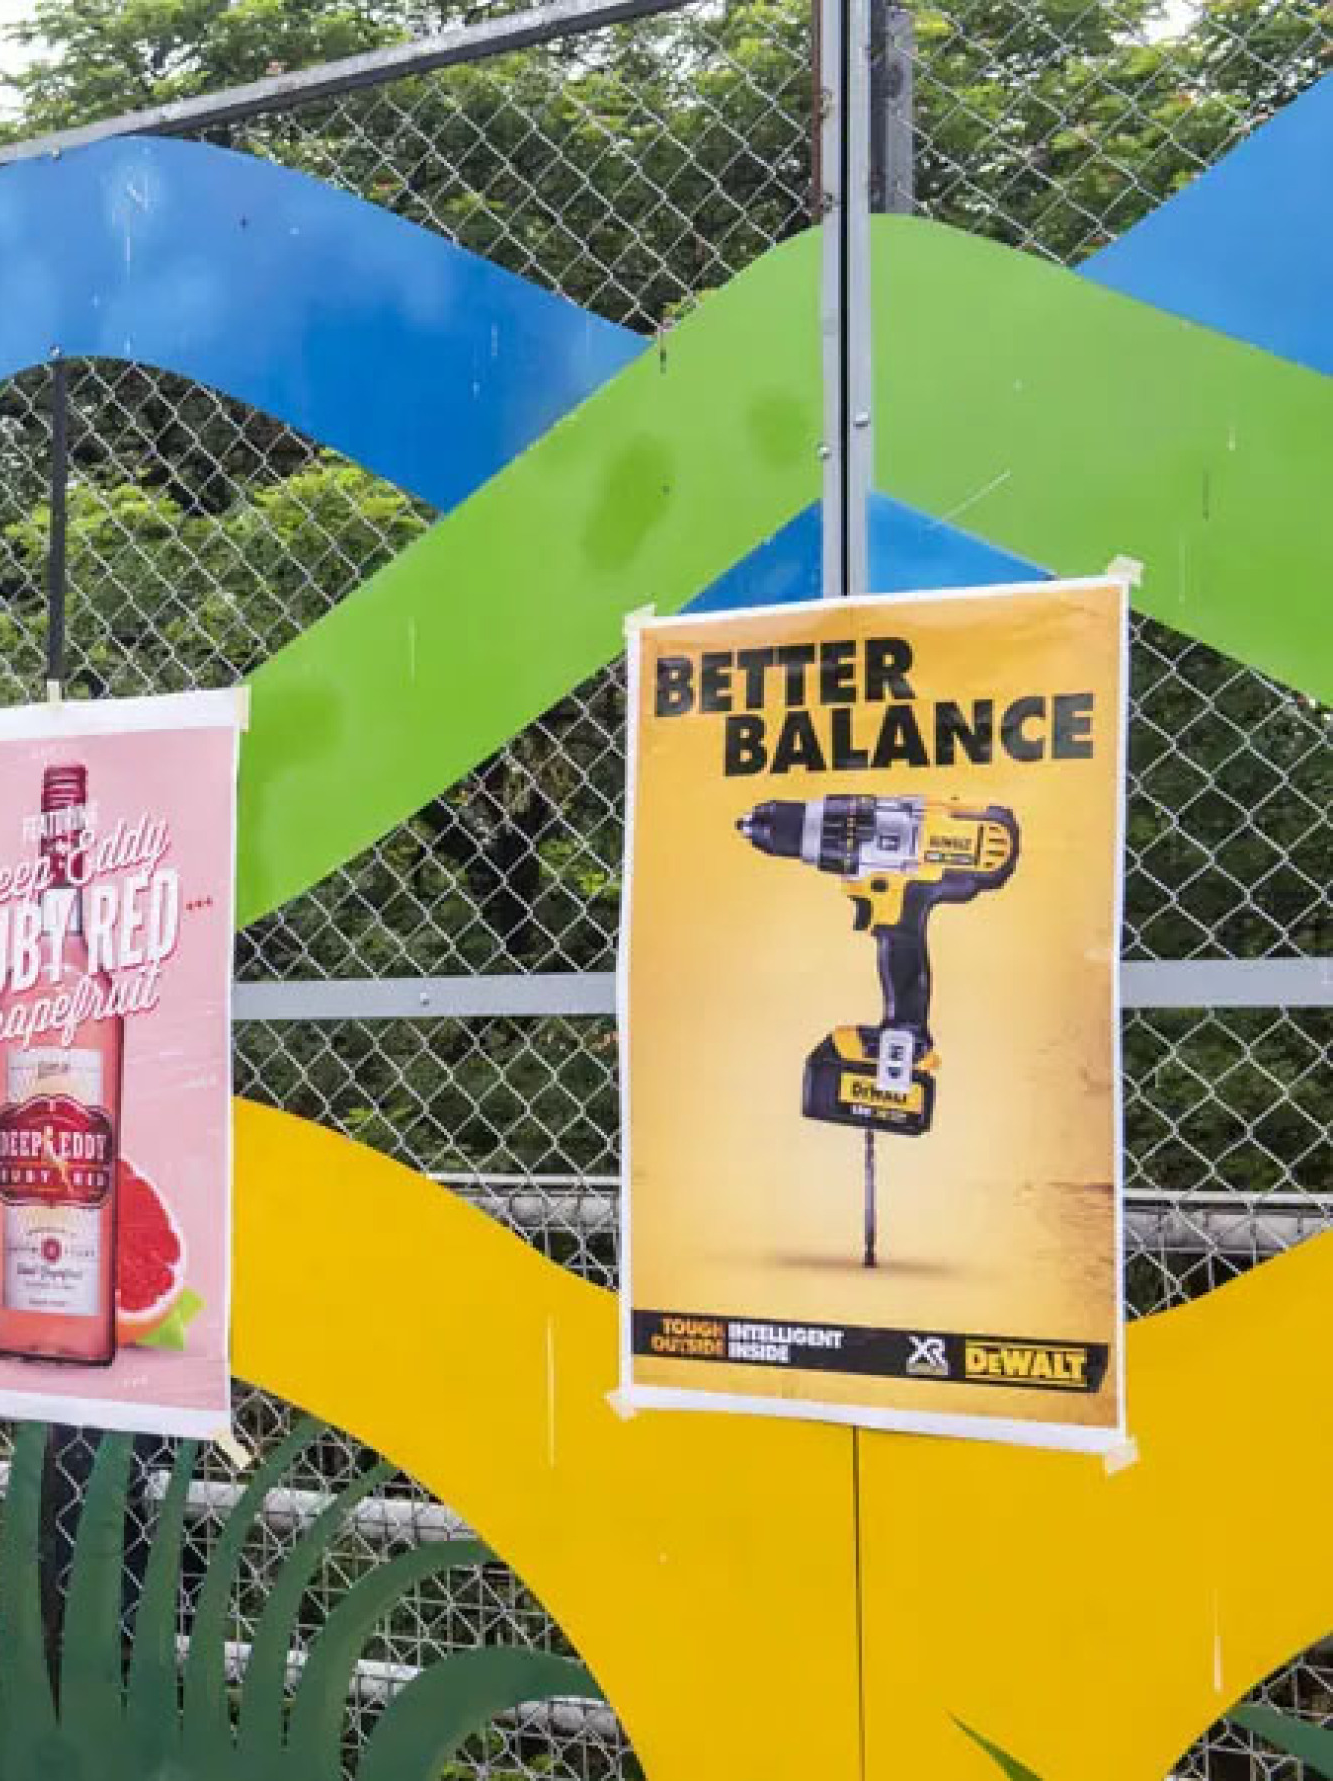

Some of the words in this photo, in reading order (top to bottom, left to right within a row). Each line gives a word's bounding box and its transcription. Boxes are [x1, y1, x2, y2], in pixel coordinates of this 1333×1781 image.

[654, 636, 916, 718] BETTER
[724, 692, 1094, 777] BALANCE
[67, 812, 172, 893] Eddy
[87, 868, 180, 973] RED
[0, 1130, 42, 1157] DEEP
[728, 1321, 845, 1349] INTELLIGENT
[728, 1342, 791, 1363] INSIDE
